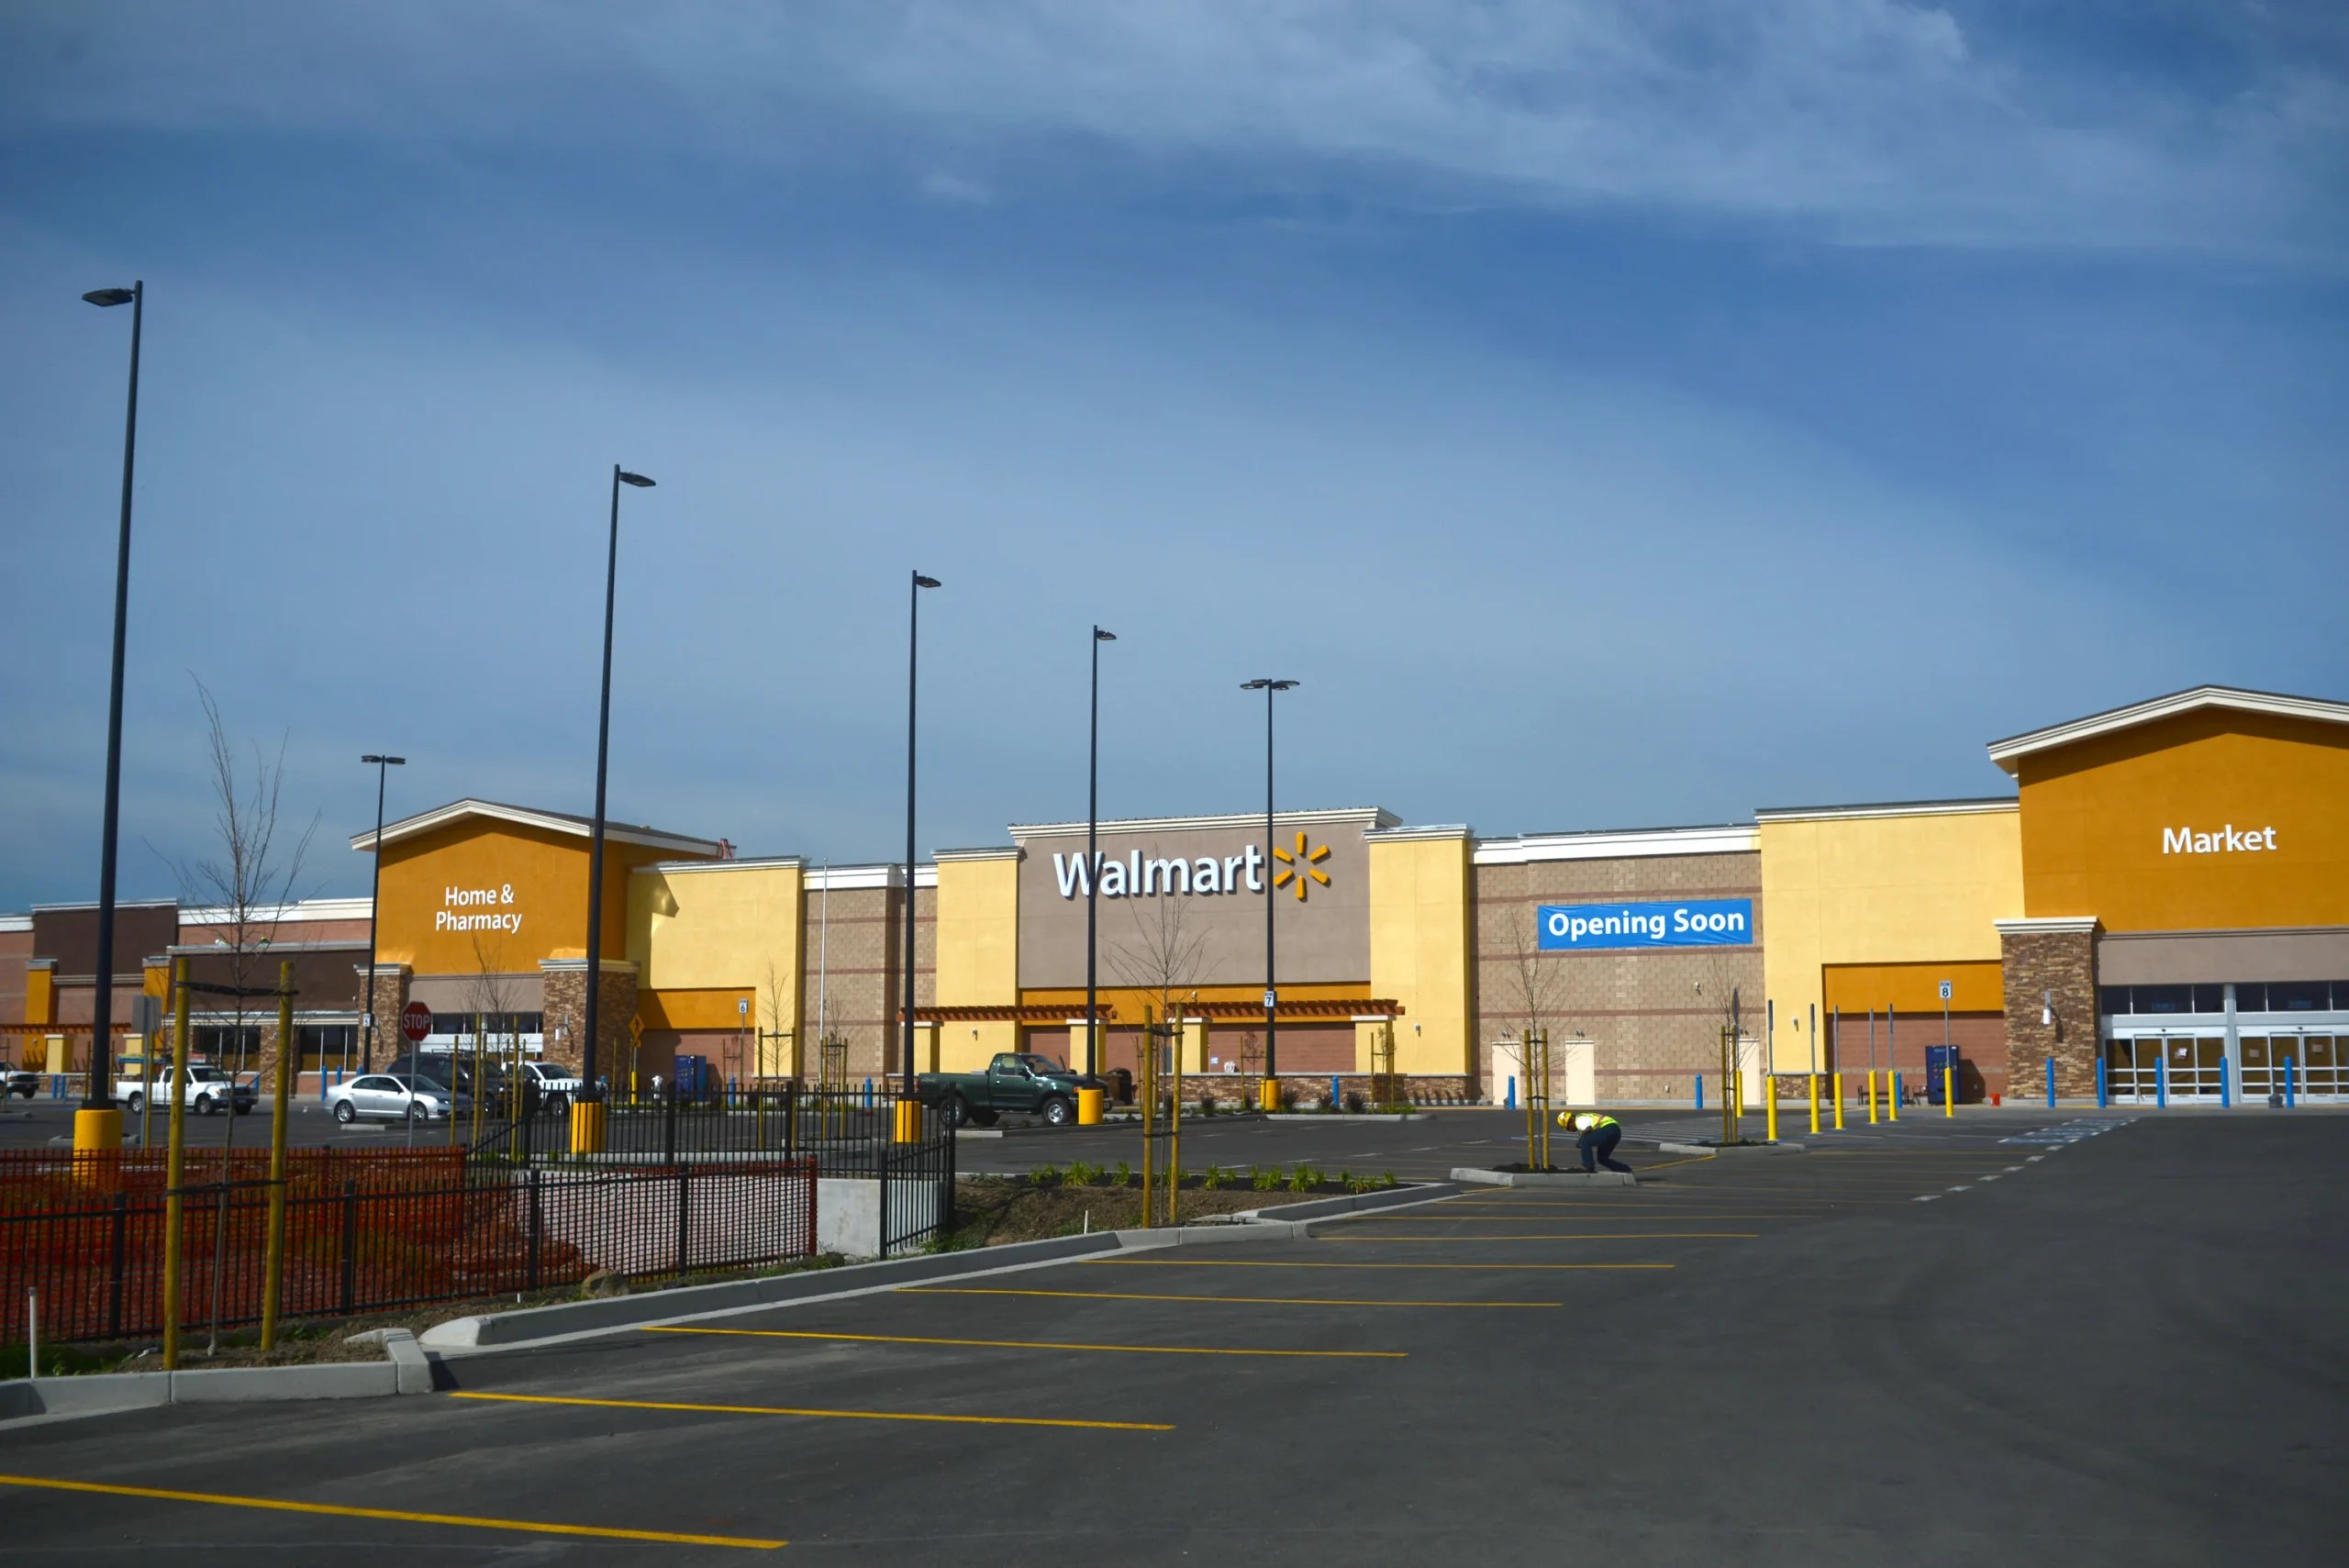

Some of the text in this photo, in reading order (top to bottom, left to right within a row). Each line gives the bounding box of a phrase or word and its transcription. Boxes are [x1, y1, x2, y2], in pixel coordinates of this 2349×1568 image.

[2162, 824, 2277, 854] Market
[1053, 844, 1264, 897] Walmart
[445, 884, 514, 906] Home &
[436, 910, 522, 934] Pharmacy
[1548, 908, 1744, 941] Opening Soon
[1265, 996, 1272, 1006] 7
[1942, 987, 1949, 997] 8
[404, 1012, 430, 1029] STOP
